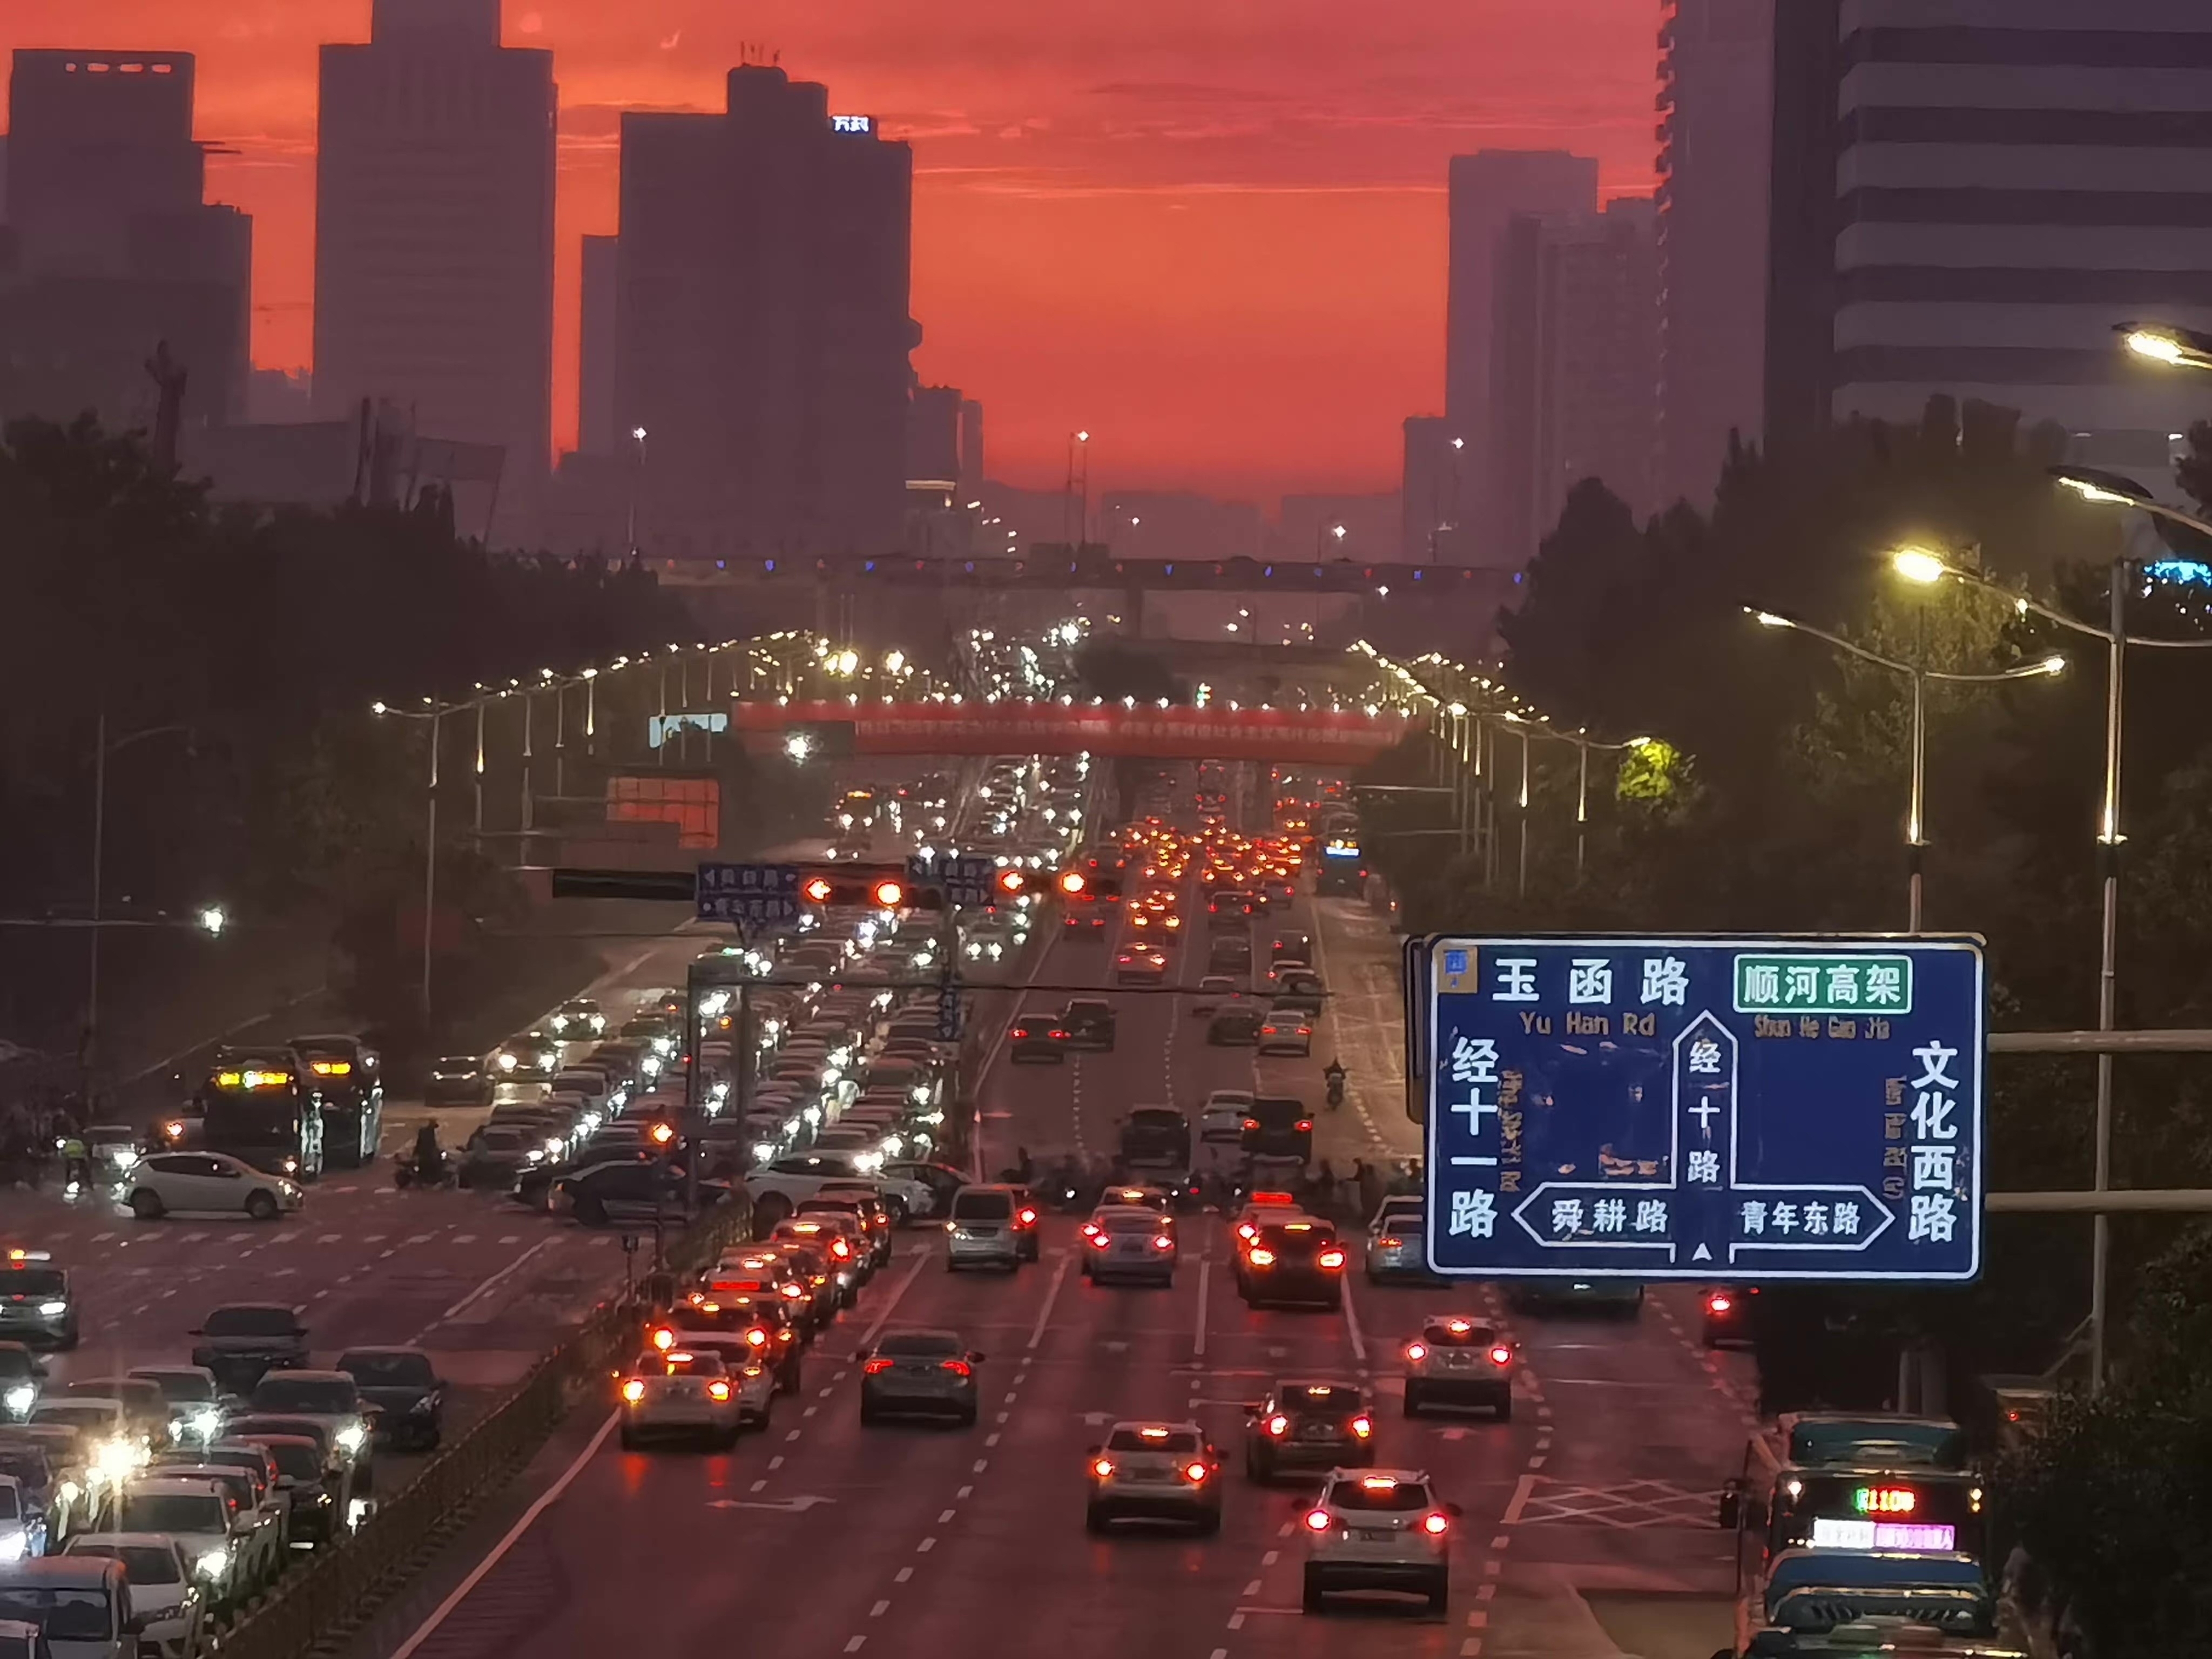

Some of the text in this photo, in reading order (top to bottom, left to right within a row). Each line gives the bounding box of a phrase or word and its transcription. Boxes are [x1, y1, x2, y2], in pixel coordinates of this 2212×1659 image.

[1492, 956, 1690, 1006] 玉函路
[1743, 963, 1901, 1005] 顺河高架
[1519, 1011, 1655, 1036] Yu Han Rd
[1687, 1041, 1722, 1183] 经十路
[1448, 1036, 1500, 1238] 经十一路
[1908, 1040, 1959, 1242] 文化西路
[1552, 1199, 1669, 1234] 舜耕路
[1740, 1200, 1861, 1236] 青年东路
